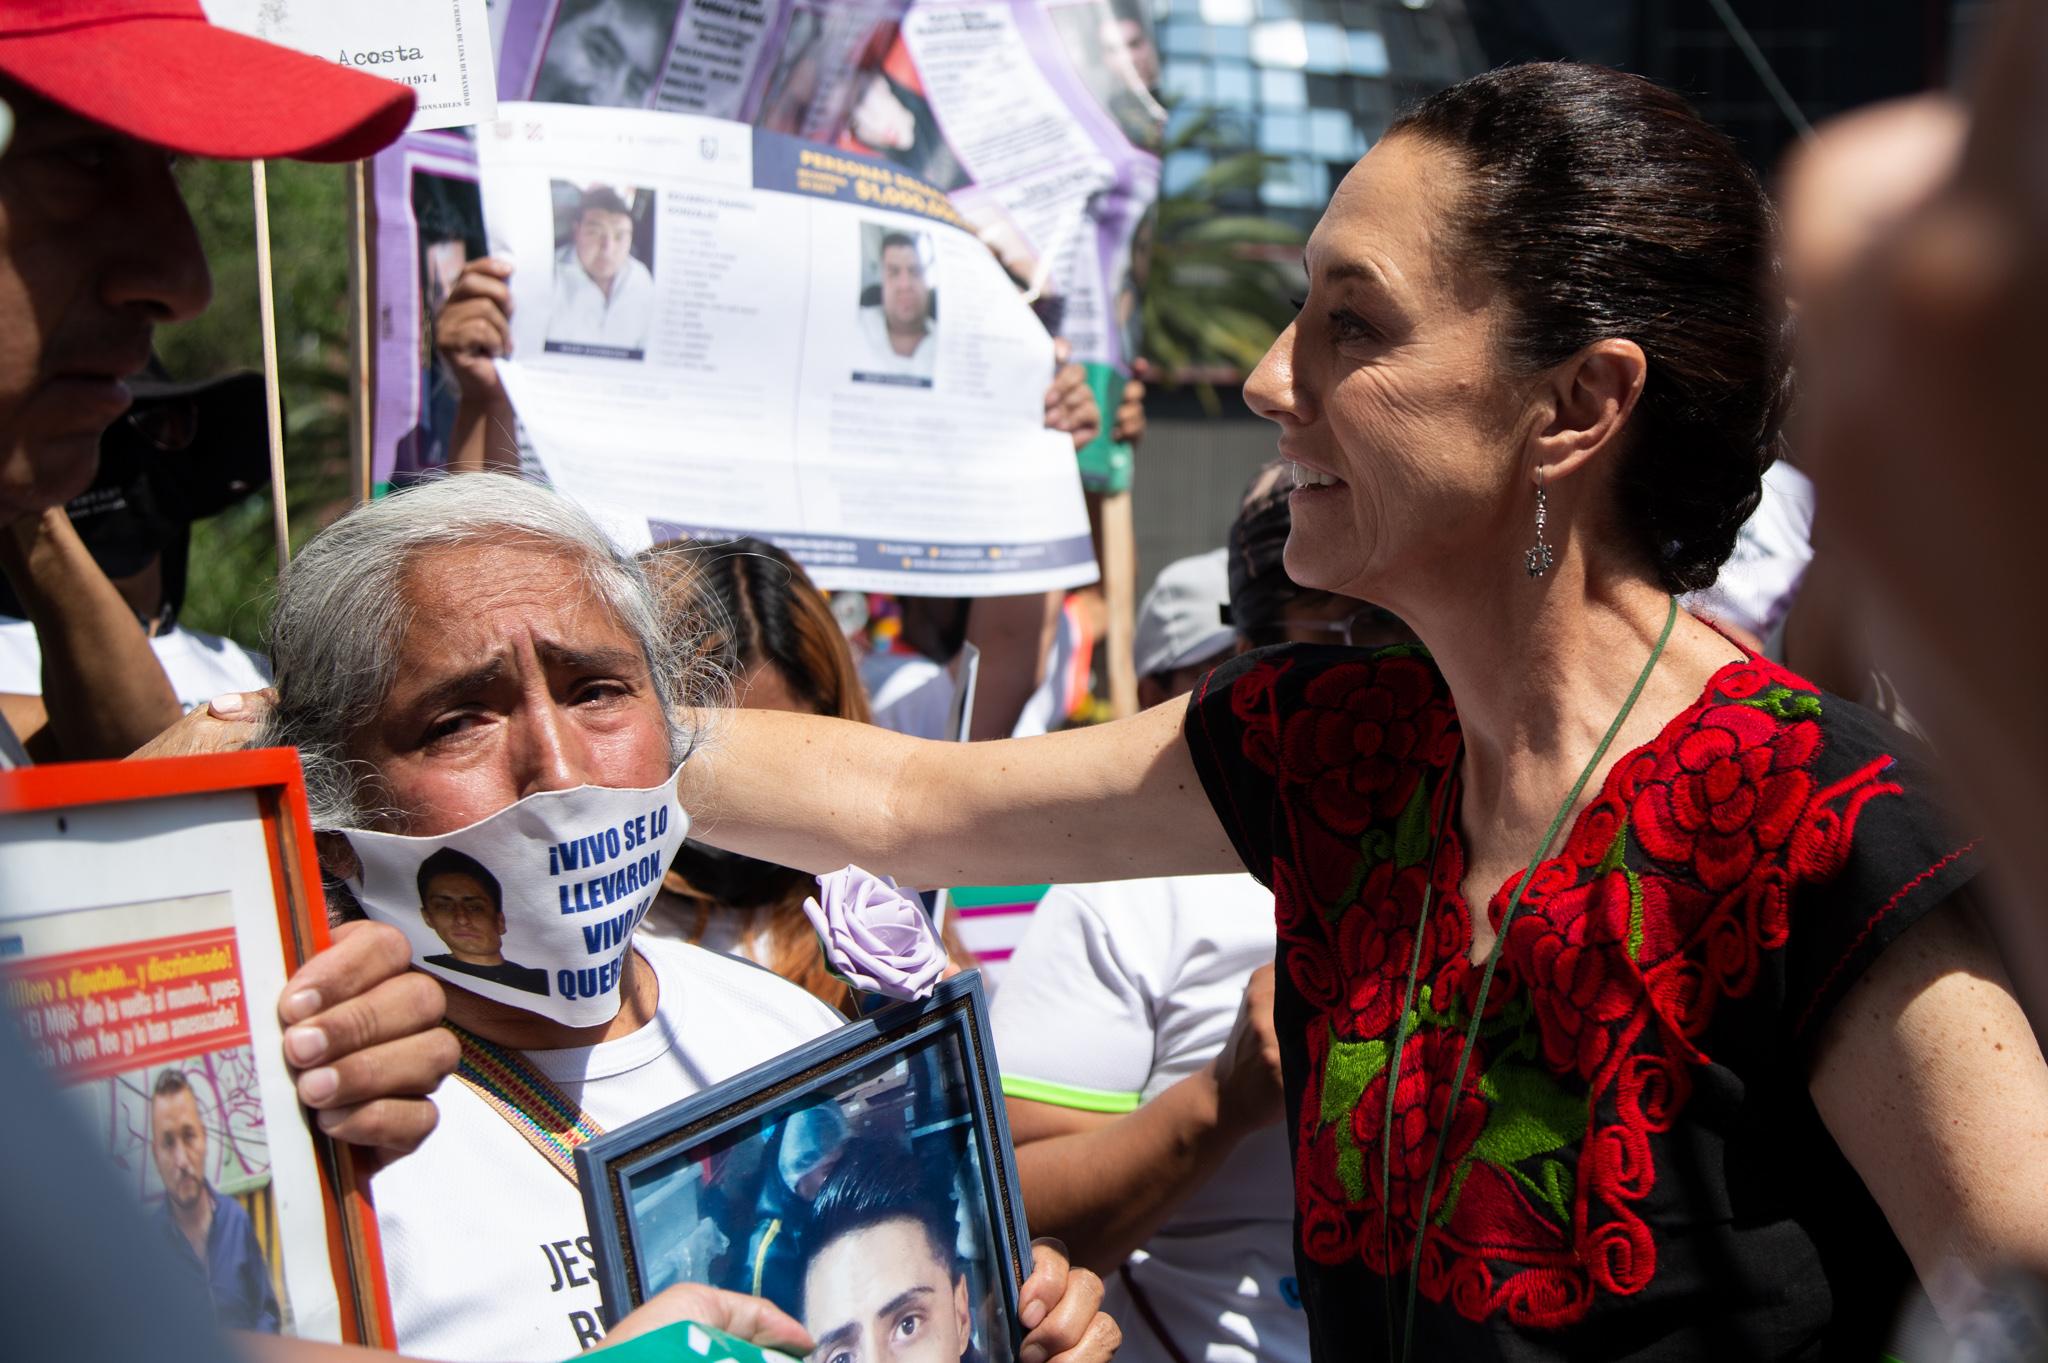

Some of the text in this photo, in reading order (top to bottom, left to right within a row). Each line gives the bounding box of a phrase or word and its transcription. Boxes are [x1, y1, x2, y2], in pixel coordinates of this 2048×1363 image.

[338, 45, 424, 66] Acosta
[416, 101, 462, 111] PONSABLES
[549, 804, 669, 876] ¡VIVO SE LO
[582, 908, 634, 955] VIVO
[540, 1235, 600, 1292] JES
[568, 1305, 608, 1351] R
